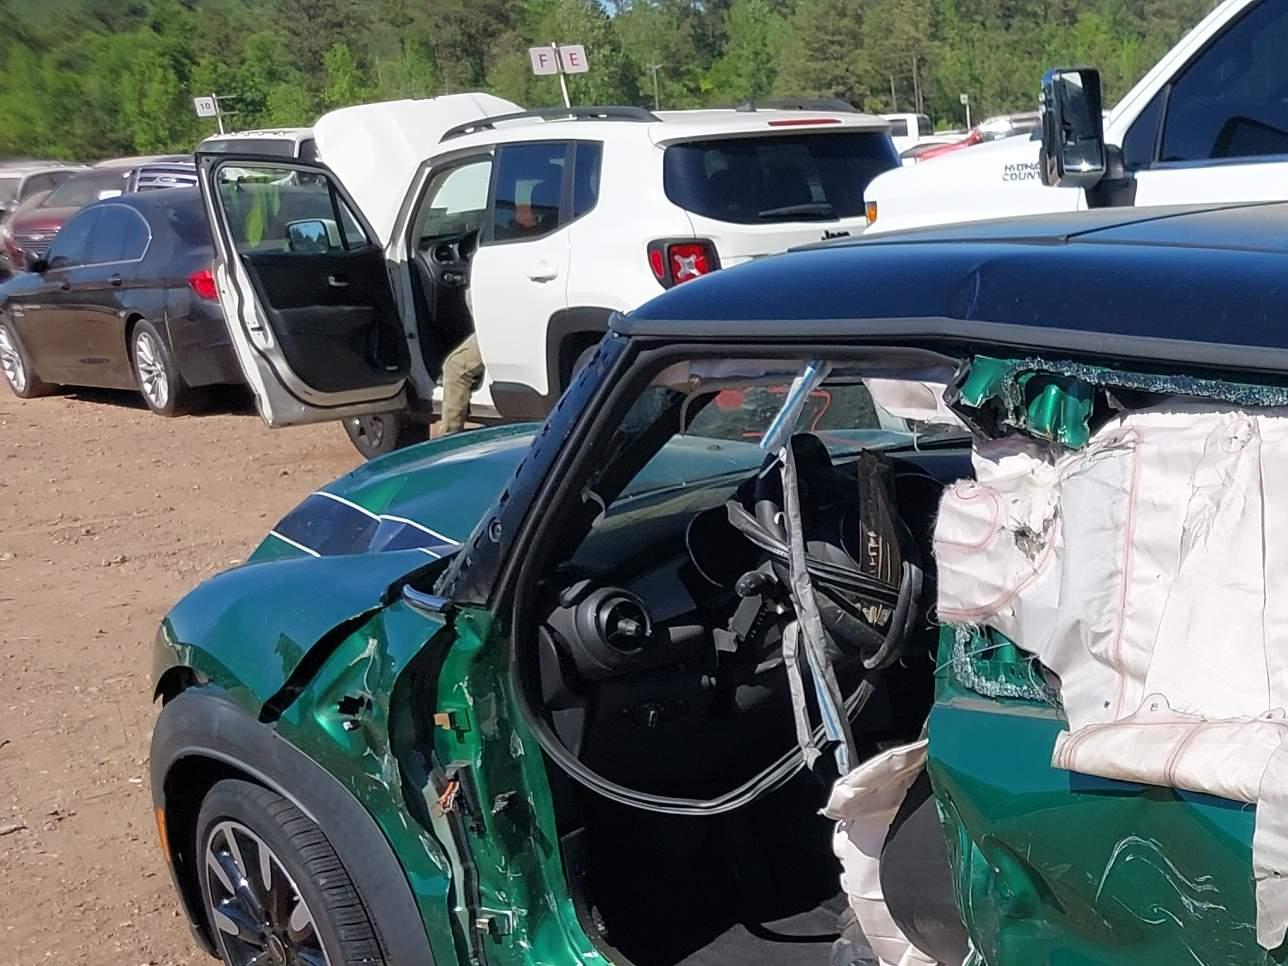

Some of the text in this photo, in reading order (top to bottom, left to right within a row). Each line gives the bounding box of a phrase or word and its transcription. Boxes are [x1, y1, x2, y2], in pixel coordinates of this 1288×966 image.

[538, 53, 580, 68] F E
[200, 102, 211, 110] 10
